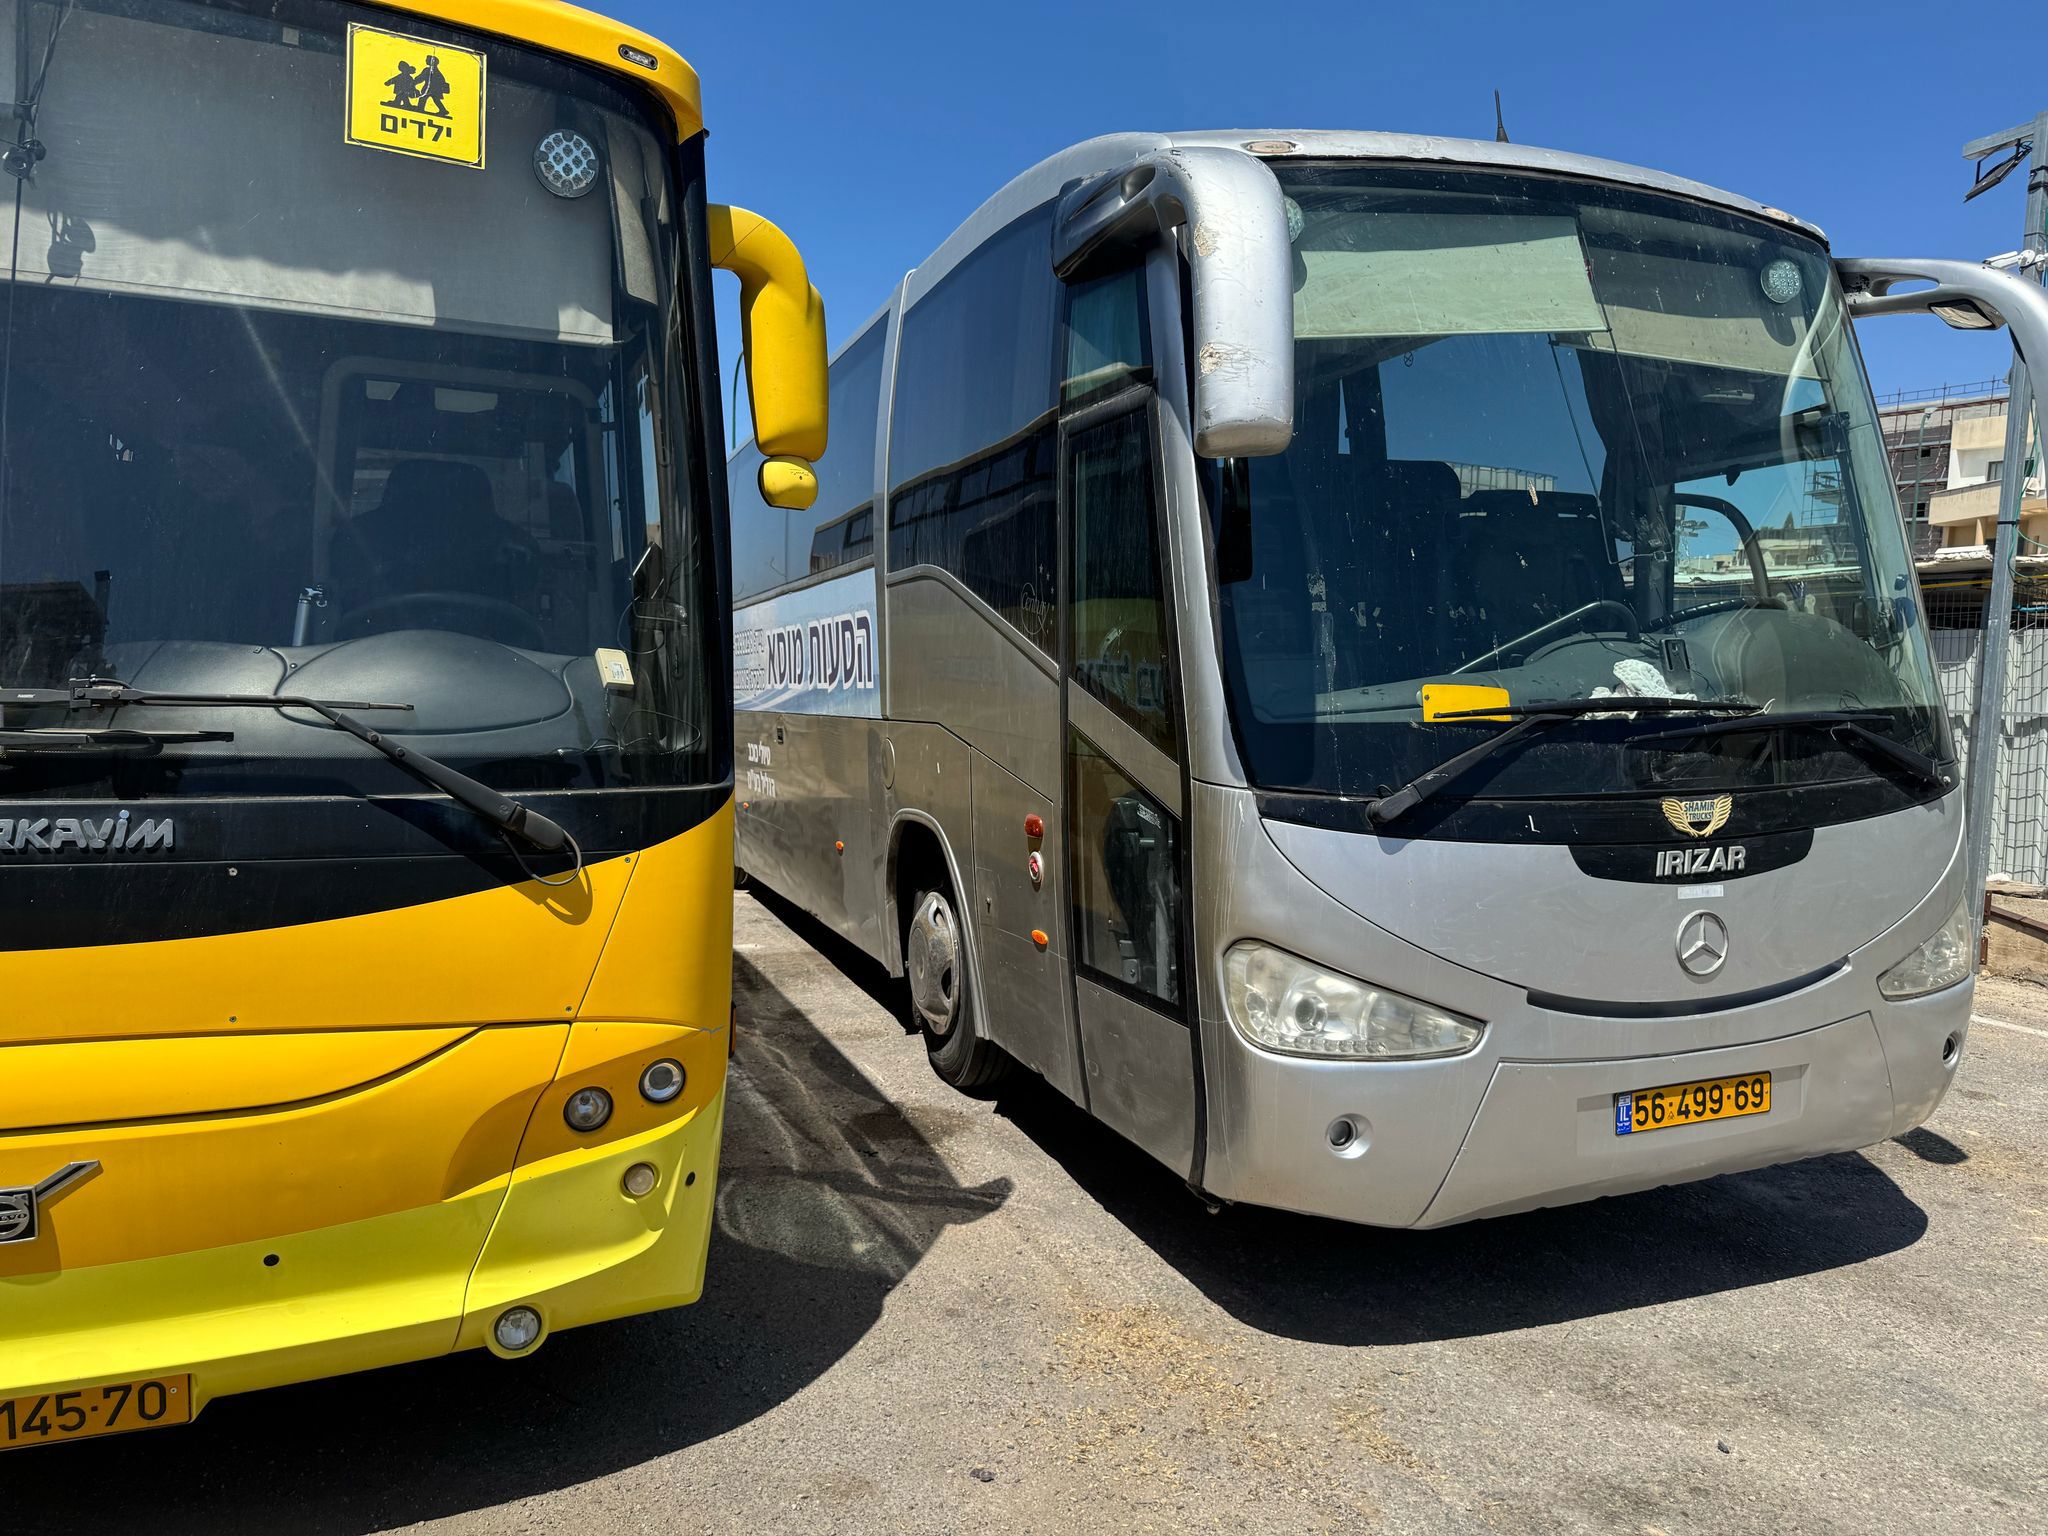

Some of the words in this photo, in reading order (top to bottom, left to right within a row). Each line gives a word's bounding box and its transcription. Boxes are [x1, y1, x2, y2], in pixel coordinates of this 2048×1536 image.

[380, 113, 452, 142] ילדים
[767, 625, 804, 686] מוסא
[808, 614, 873, 688] הסעות
[1684, 801, 1715, 812] SHAMIR
[1689, 812, 1712, 821] TRUCKS
[1655, 846, 1746, 878] IRIZAR
[1619, 1106, 1630, 1122] IL
